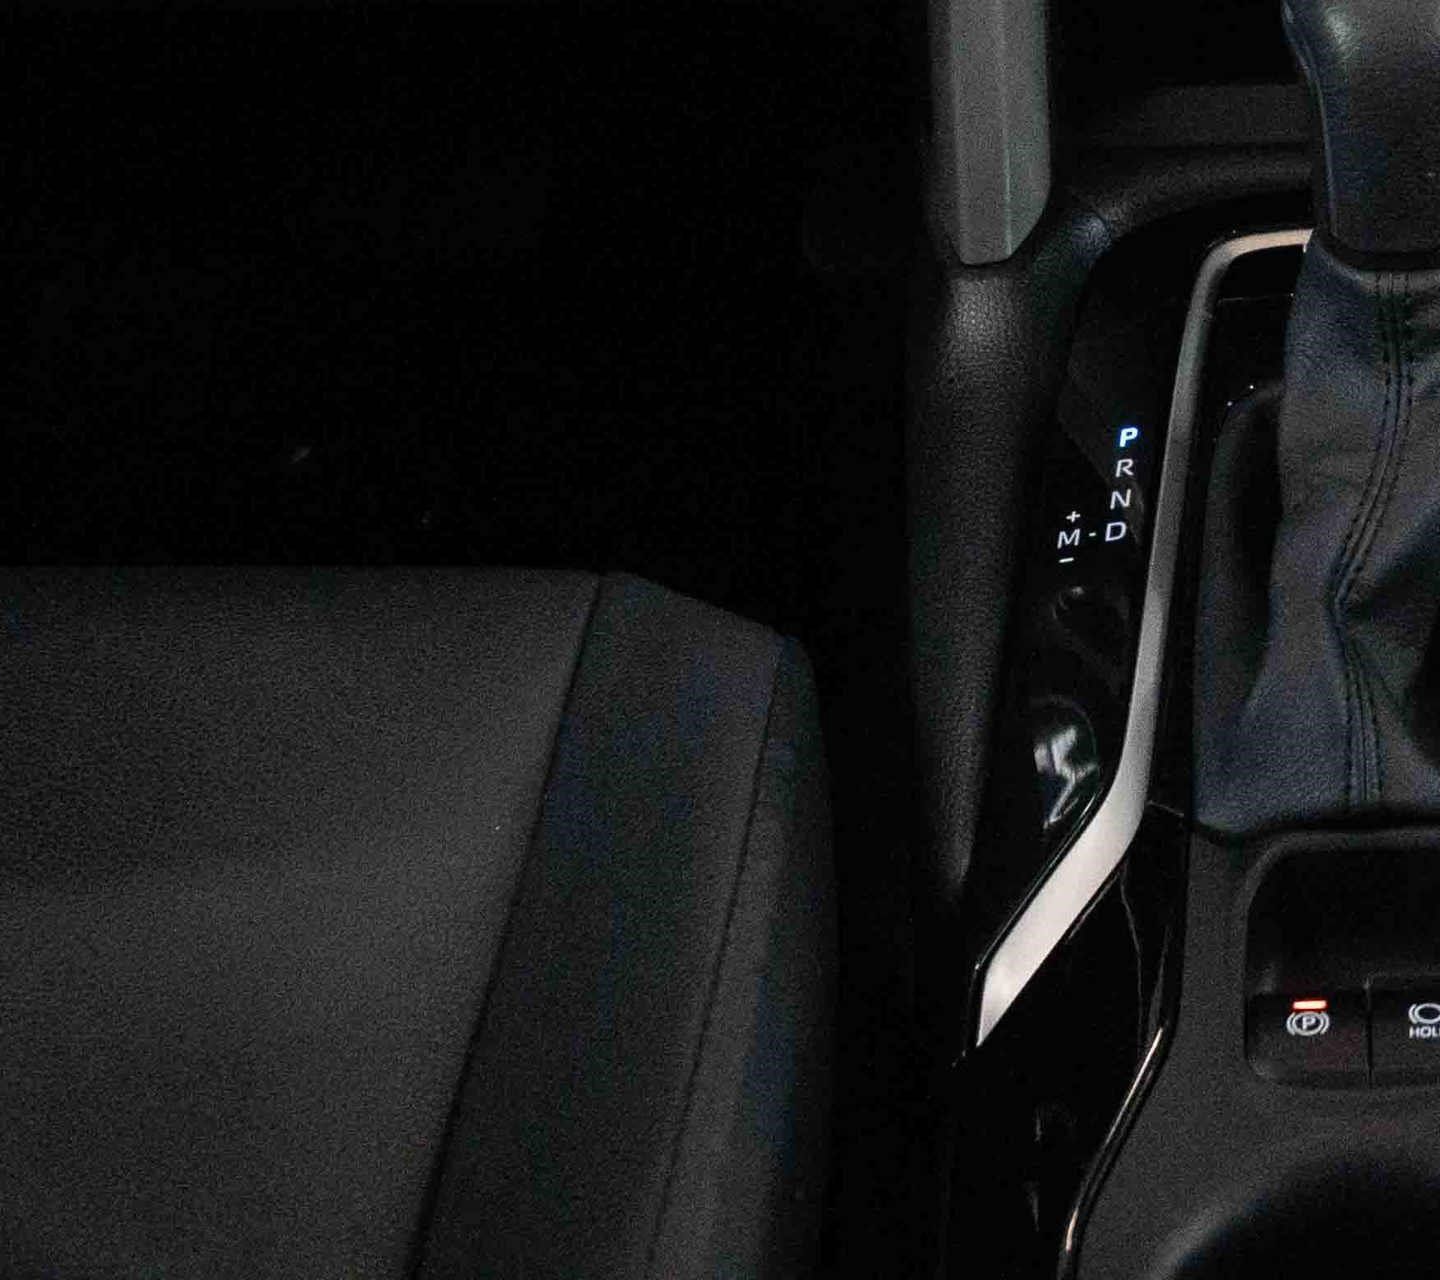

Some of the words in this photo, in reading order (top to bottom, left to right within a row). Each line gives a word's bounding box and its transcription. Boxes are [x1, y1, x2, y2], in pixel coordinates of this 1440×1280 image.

[1119, 427, 1139, 448] P
[1115, 458, 1134, 477] R
[1110, 488, 1132, 510] N
[1057, 528, 1081, 549] M
[1105, 521, 1127, 542] D
